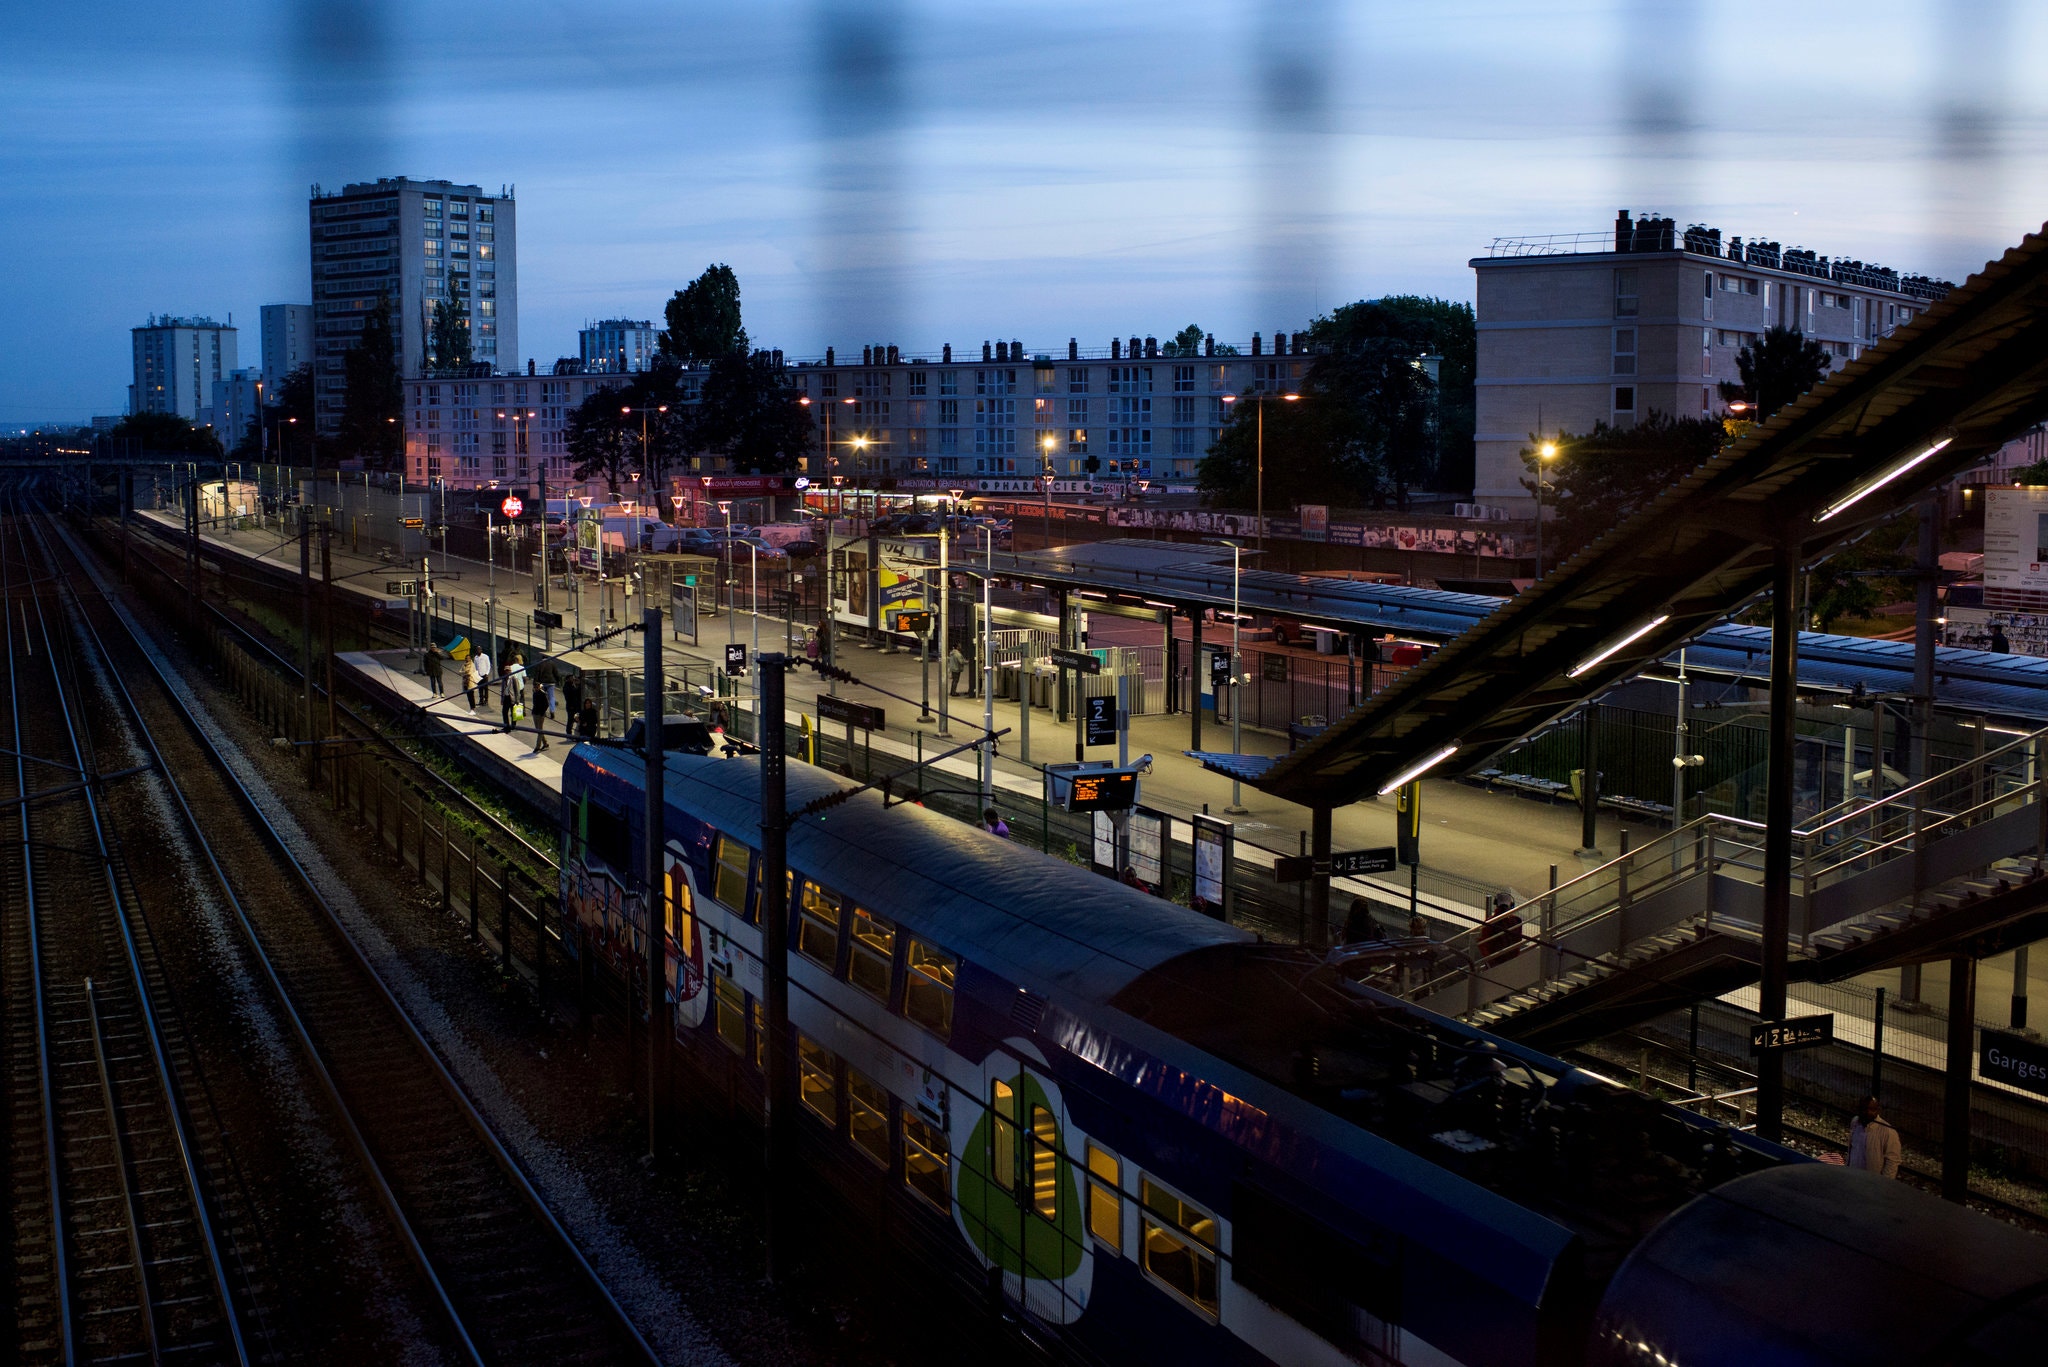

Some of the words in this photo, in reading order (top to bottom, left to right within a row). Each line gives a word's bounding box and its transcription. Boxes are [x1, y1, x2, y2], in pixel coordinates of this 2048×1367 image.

[897, 480, 936, 488] ALIMENTATION
[995, 481, 1076, 491] PHARCIE
[1004, 504, 1015, 515] LA
[1017, 505, 1066, 520] LOCOMTIVE
[402, 583, 415, 594] T1
[1094, 706, 1103, 719] 2
[1350, 860, 1356, 869] 2
[1772, 1034, 1779, 1045] 2
[1988, 1048, 2046, 1080] Garges
